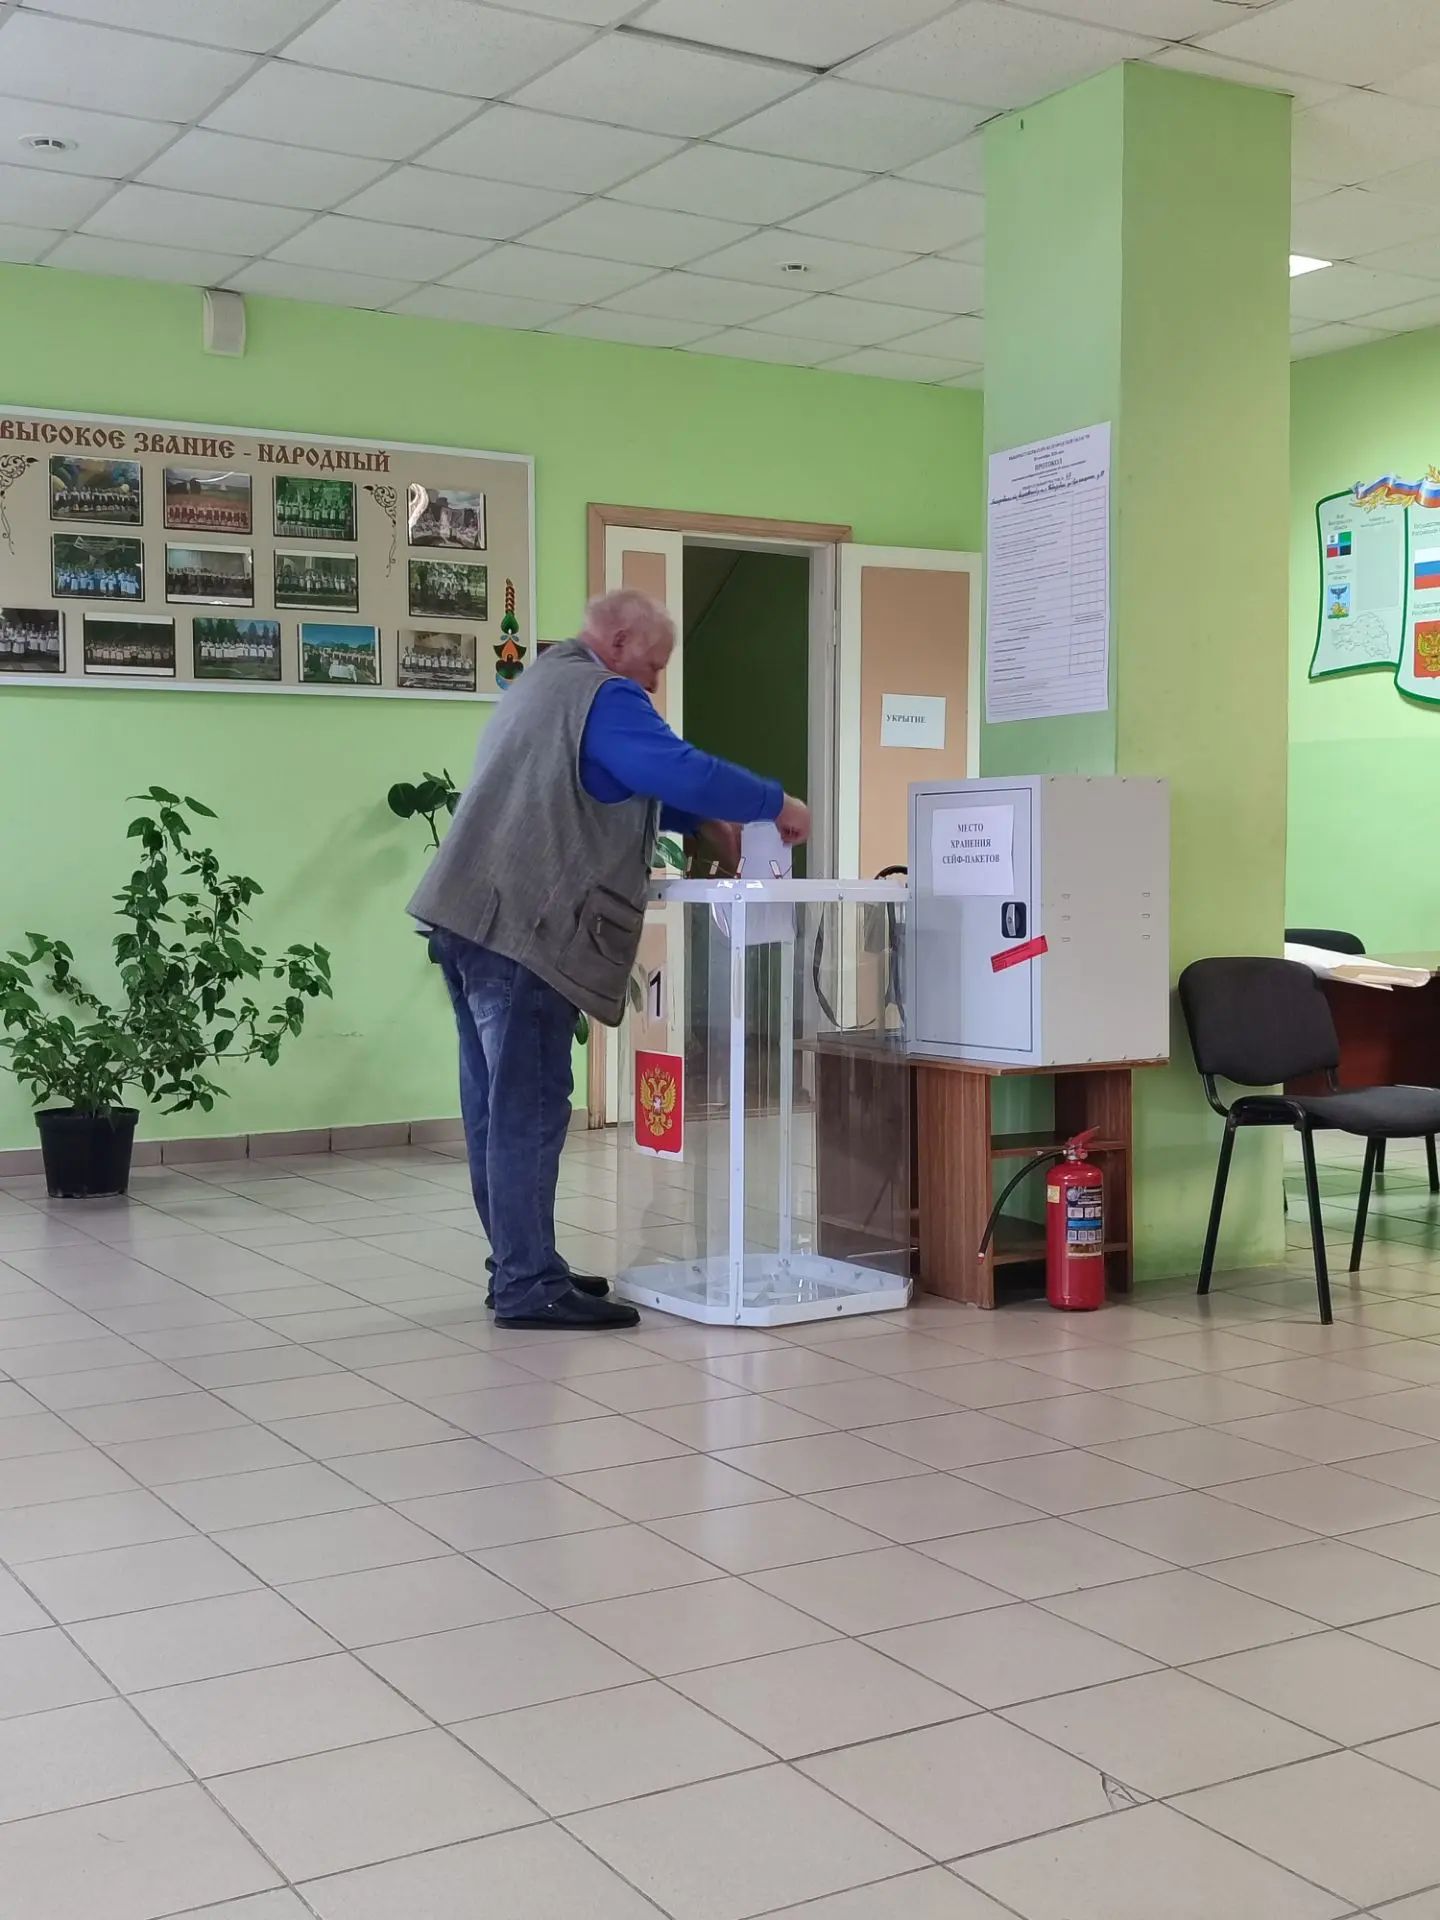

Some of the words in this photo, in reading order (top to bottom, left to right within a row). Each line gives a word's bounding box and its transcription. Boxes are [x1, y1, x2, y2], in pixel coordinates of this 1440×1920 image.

[0, 420, 126, 449] ВЫСОКОЕ
[134, 432, 235, 459] ЗВАНИЕ
[257, 443, 391, 472] НАРОДНЫЙ
[886, 714, 927, 724] УКРЫТИЕ
[957, 823, 984, 833] МЕСТО
[950, 838, 992, 849] ХРАНЕНИЯ
[942, 854, 1001, 865] СЕЙФ-ПАКЕТОВ
[649, 970, 662, 1017] 1
